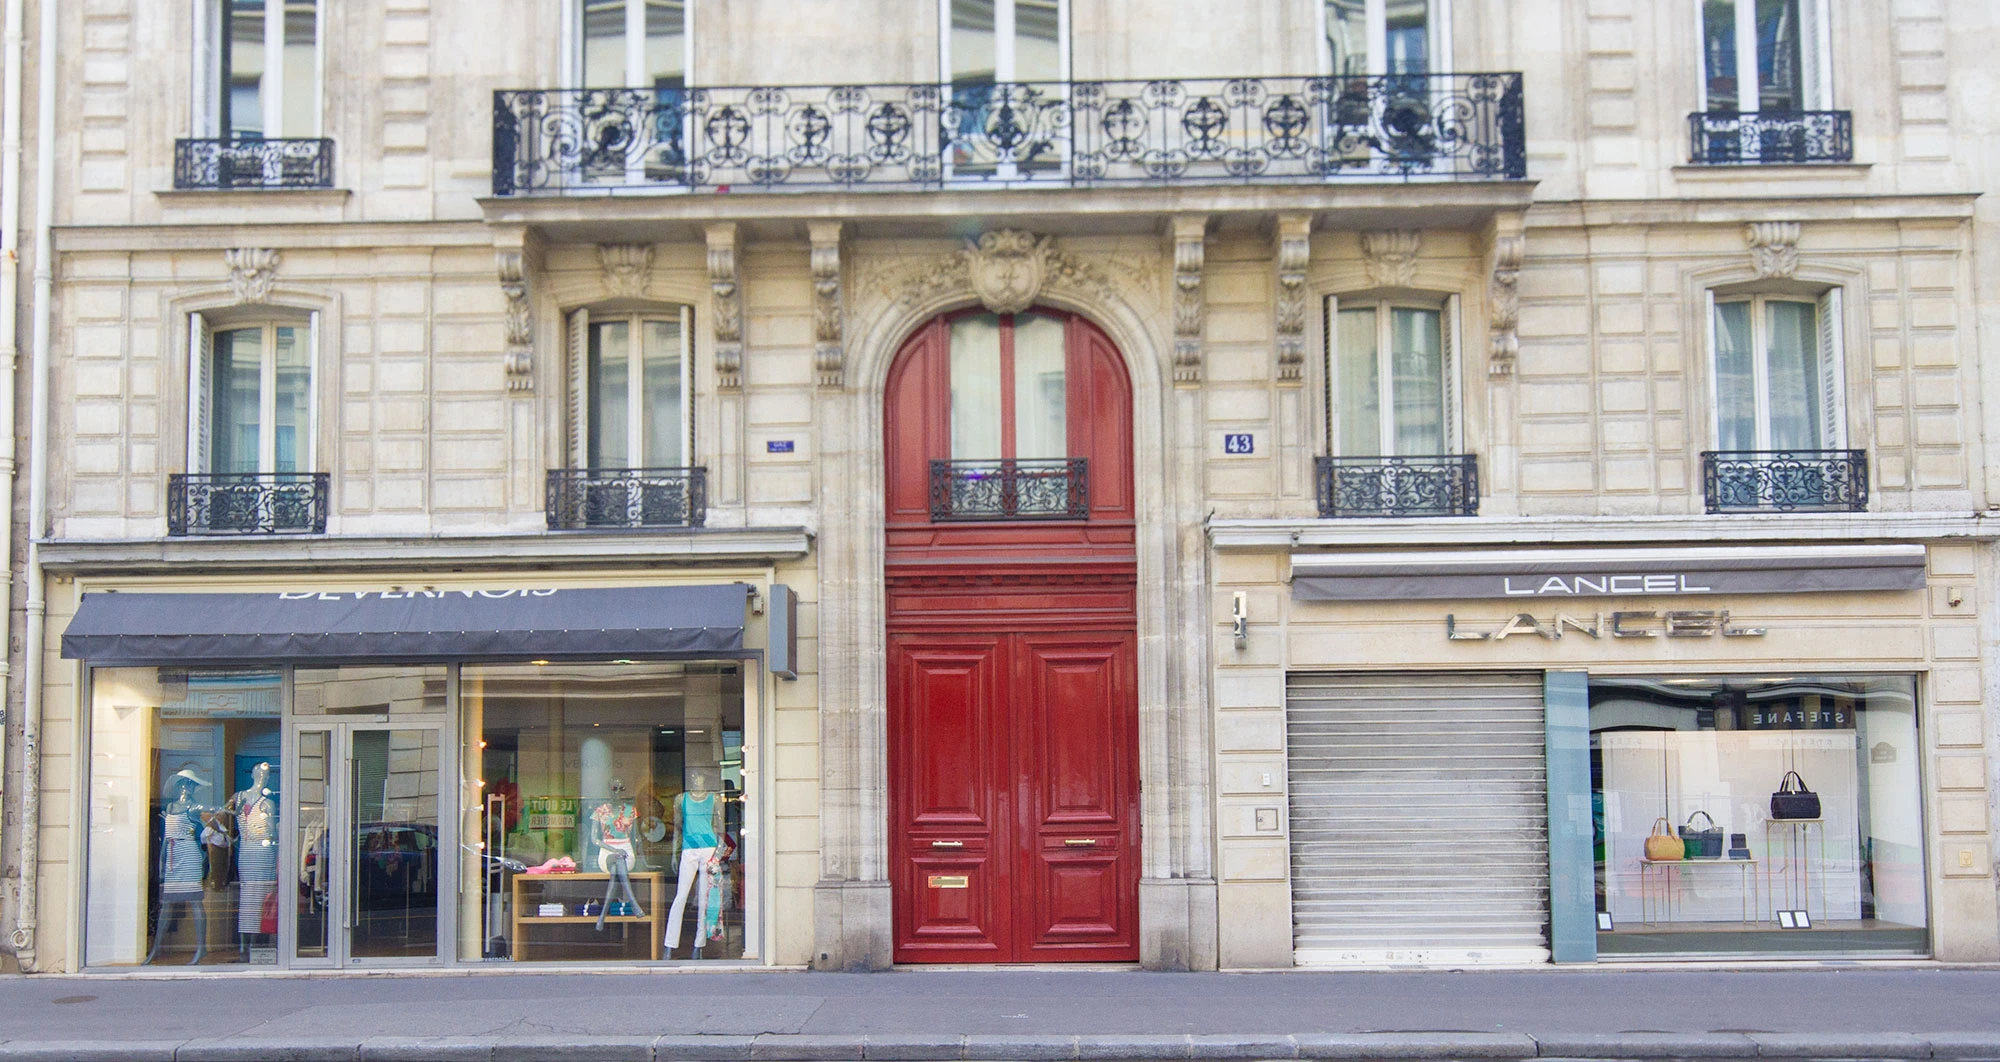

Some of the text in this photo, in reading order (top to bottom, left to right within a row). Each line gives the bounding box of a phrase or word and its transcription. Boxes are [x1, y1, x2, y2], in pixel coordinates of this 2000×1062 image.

[1227, 435, 1251, 453] 43
[1504, 574, 1711, 595] LANCEL
[1447, 610, 1768, 641] LANCEL
